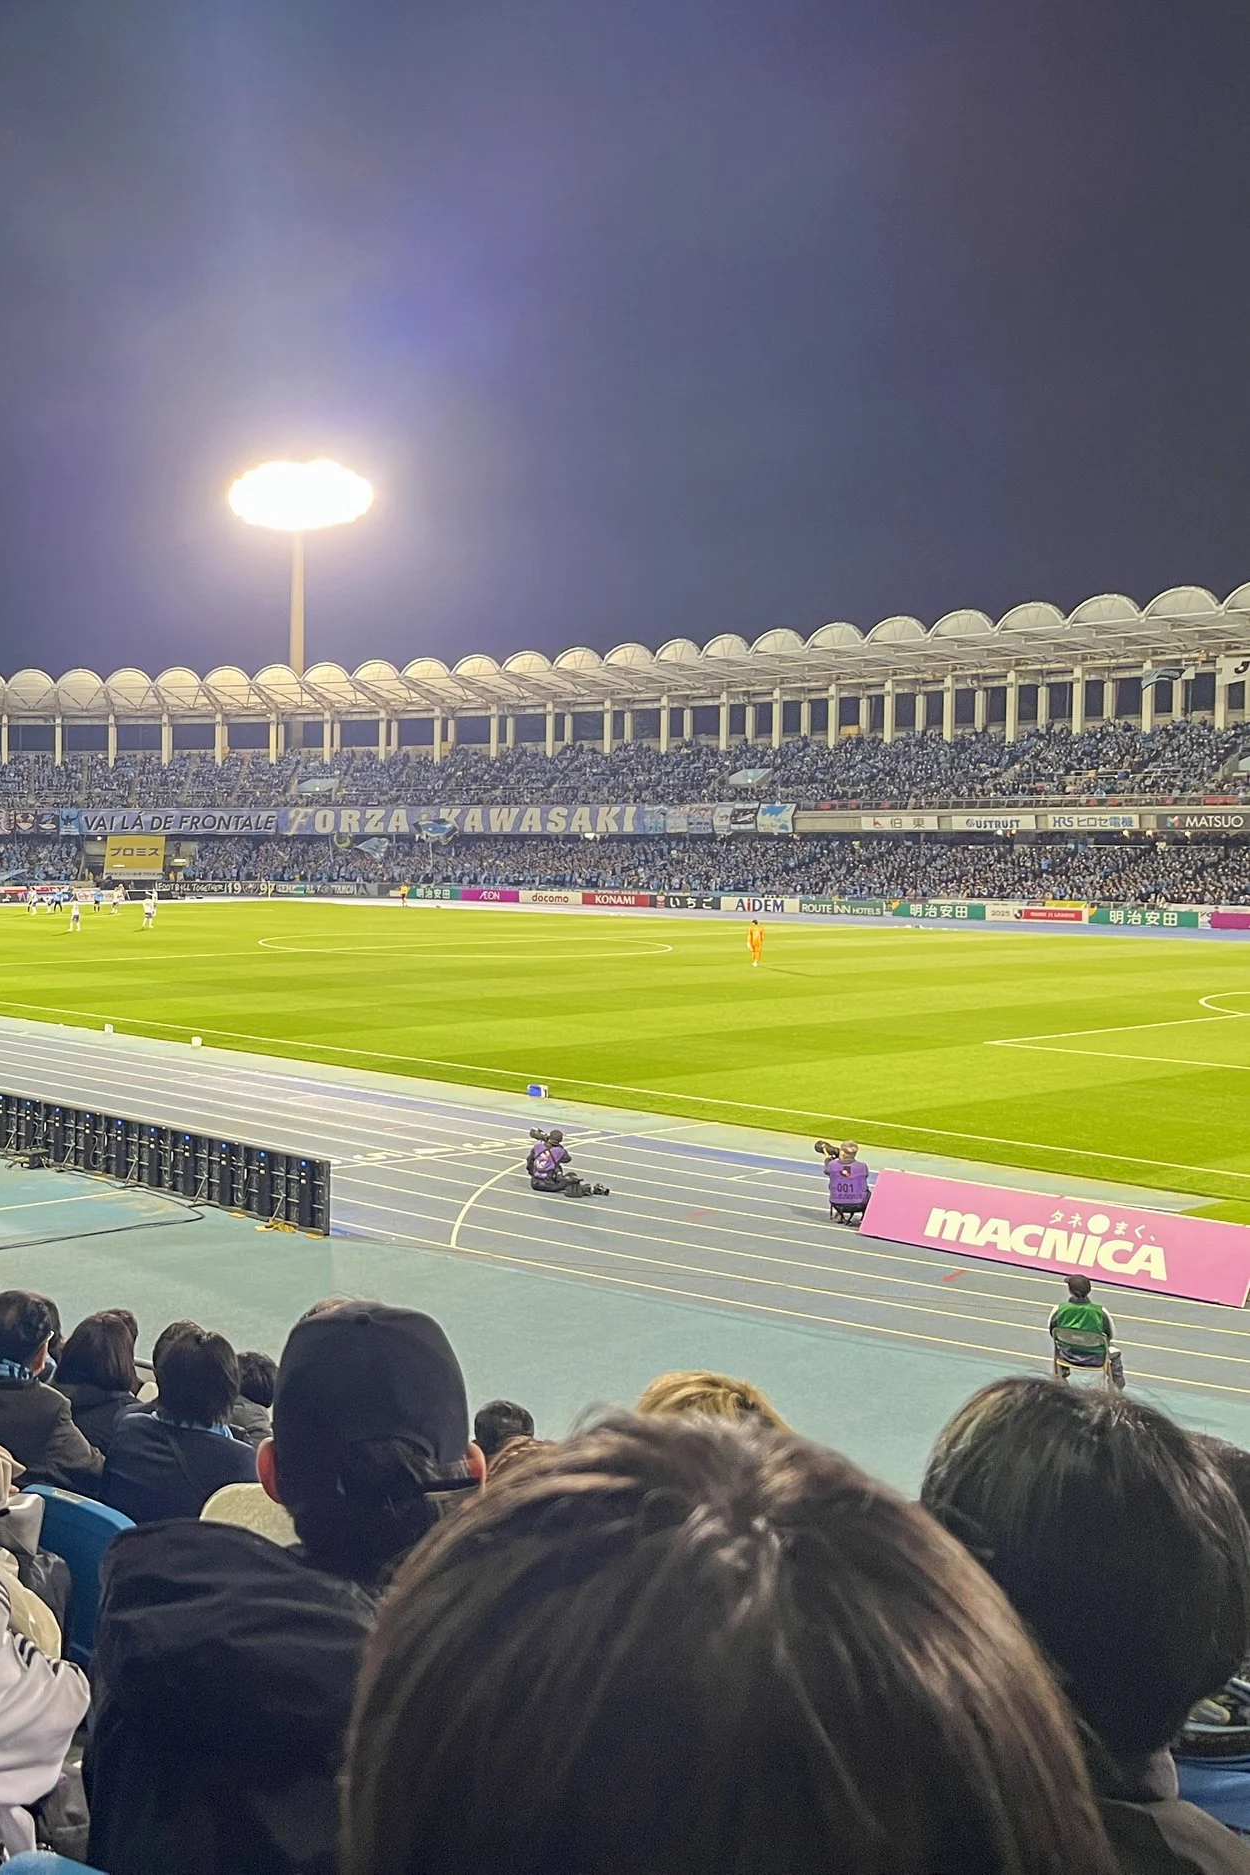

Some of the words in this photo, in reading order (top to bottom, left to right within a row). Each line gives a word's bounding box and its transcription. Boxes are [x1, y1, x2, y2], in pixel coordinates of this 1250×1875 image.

[84, 816, 115, 830] VAI
[121, 812, 144, 830] LÁ
[150, 816, 174, 830] DE
[178, 815, 276, 830] FRONTALE
[287, 808, 409, 834] FORZA
[439, 807, 637, 833] KAWASAKI
[1185, 815, 1244, 828] MATSUO
[110, 847, 159, 857] プロミス
[416, 889, 450, 898] 明治安田
[532, 893, 569, 903] docomo
[595, 895, 635, 905] KONAMI
[669, 897, 714, 909] いちご
[802, 904, 833, 913] ROUTE
[910, 904, 968, 918] 明治安田
[1109, 911, 1178, 926] 明治安田
[837, 1183, 854, 1193] 001
